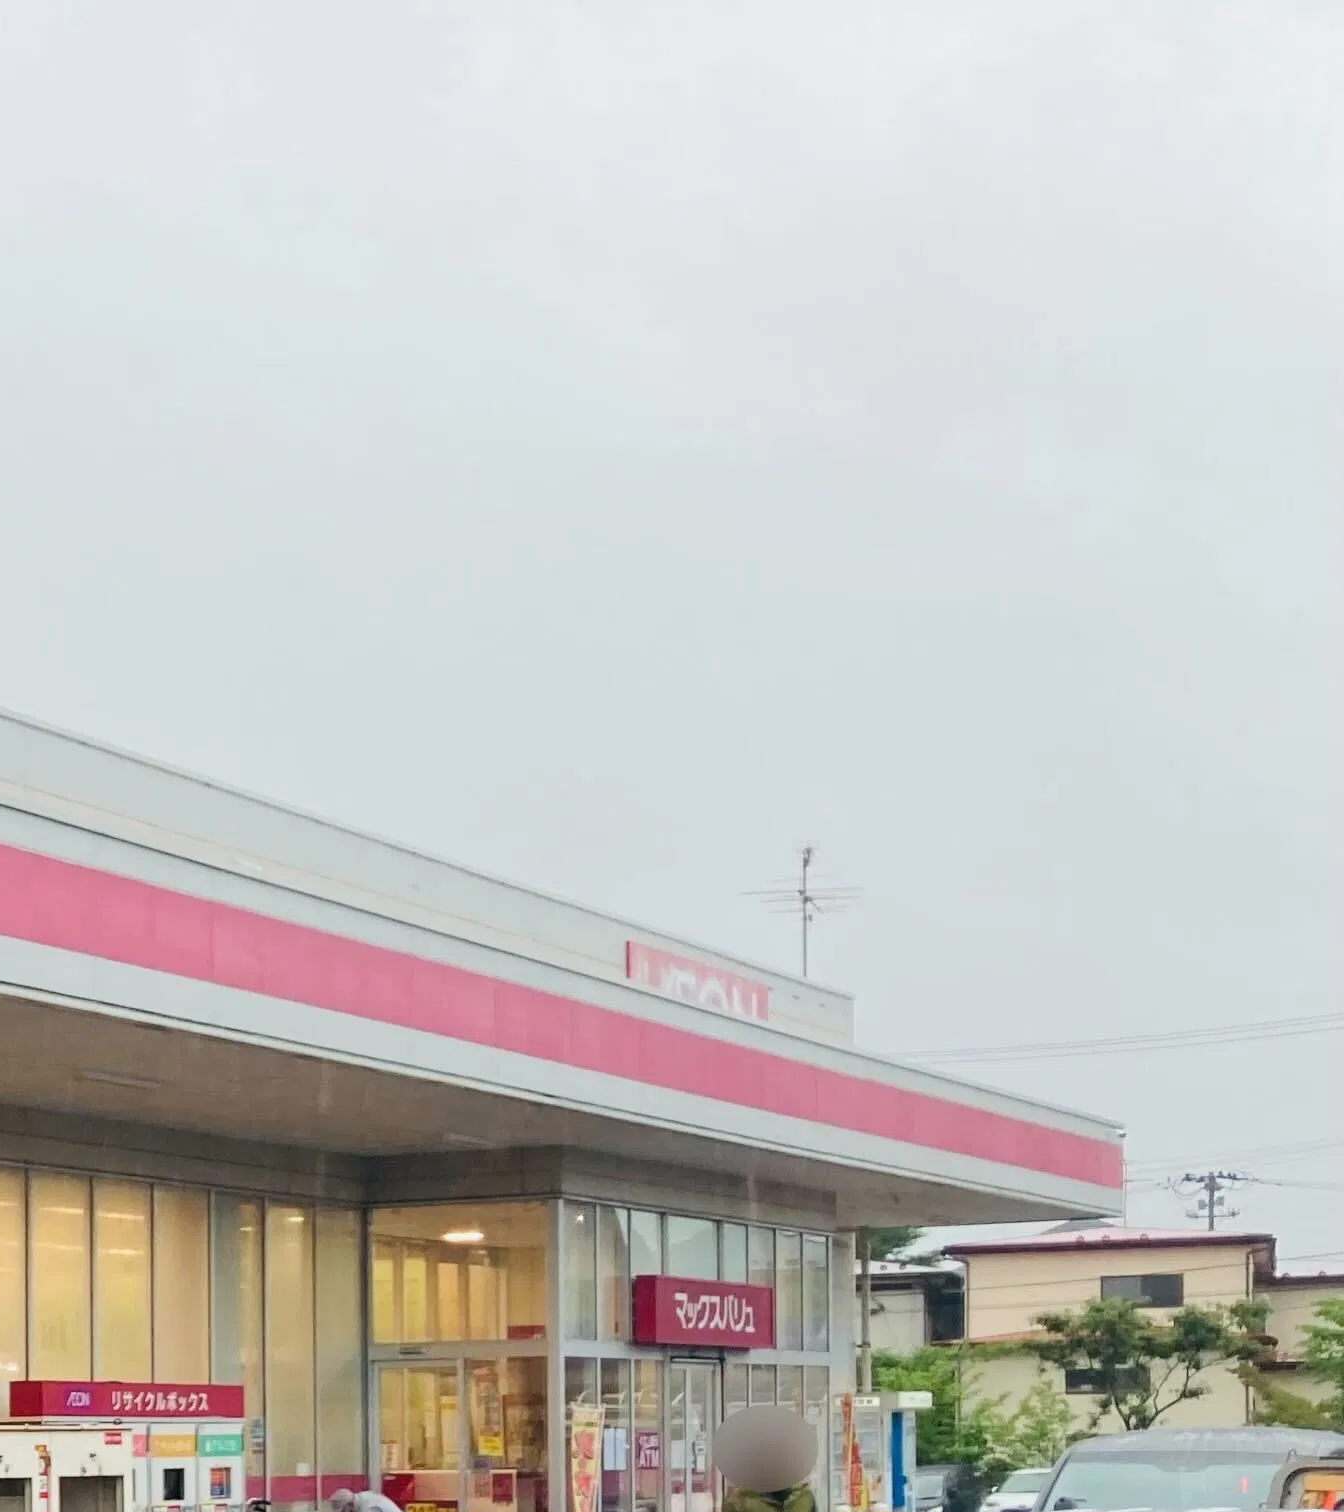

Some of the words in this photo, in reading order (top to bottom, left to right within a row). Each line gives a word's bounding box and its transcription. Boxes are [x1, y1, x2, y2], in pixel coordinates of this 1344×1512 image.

[674, 1292, 756, 1334] マックスバリュ
